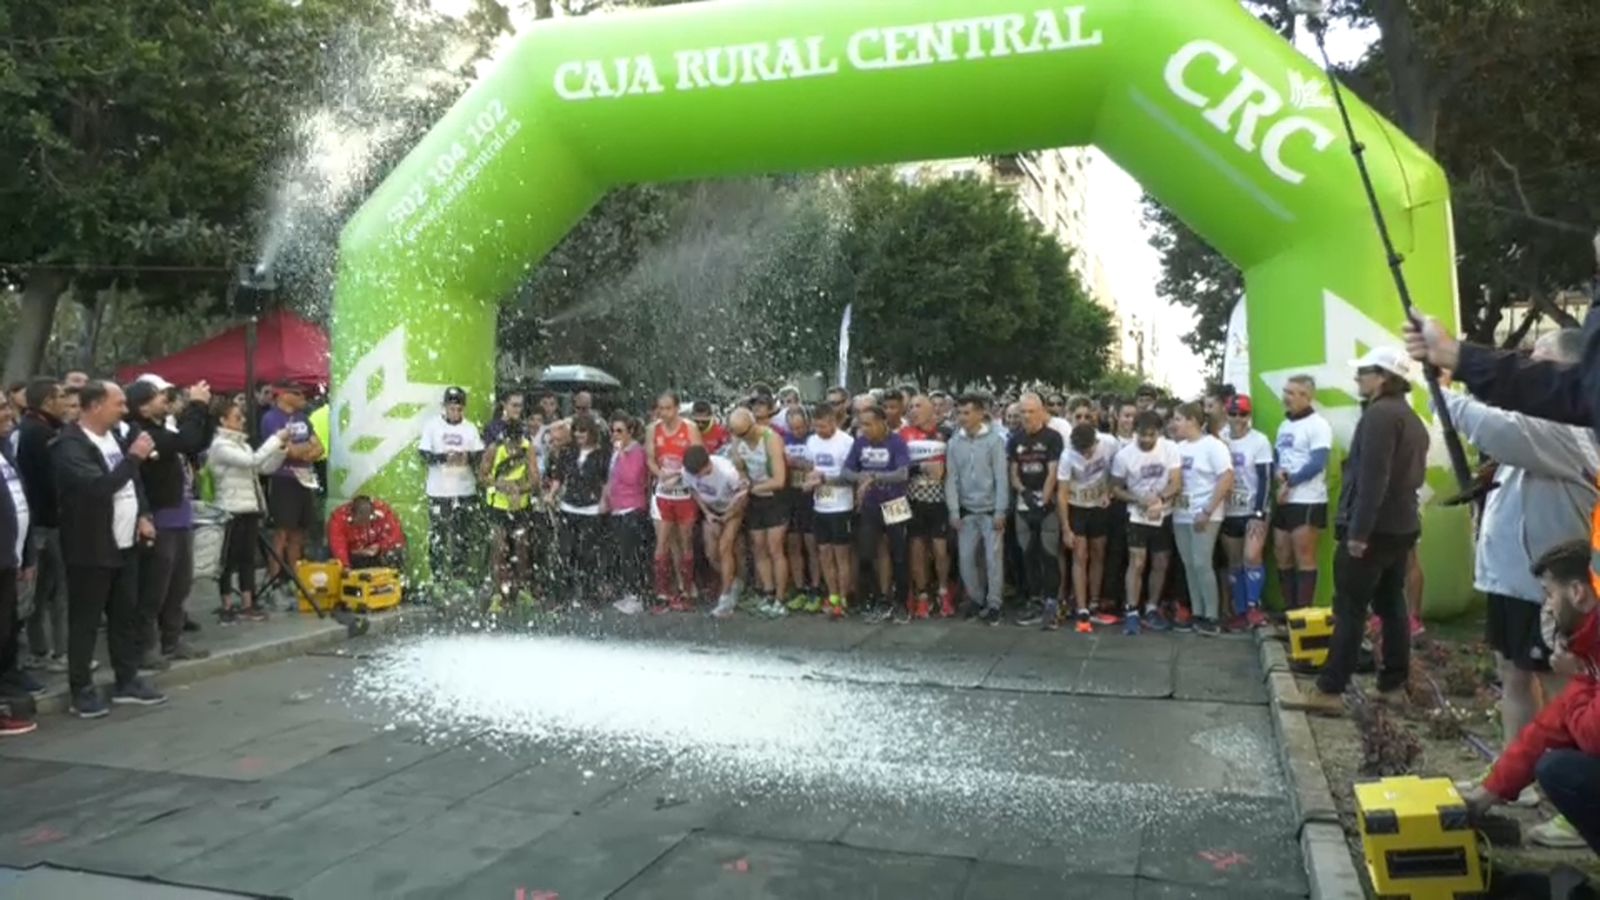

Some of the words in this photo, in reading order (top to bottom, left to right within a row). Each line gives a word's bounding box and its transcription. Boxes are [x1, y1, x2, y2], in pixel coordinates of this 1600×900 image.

[553, 53, 665, 101] CAJA
[675, 35, 838, 90] RURAL
[846, 5, 1103, 71] CENTRAL
[428, 142, 467, 187] 104
[466, 98, 508, 147] 102
[1163, 39, 1336, 184] CRC
